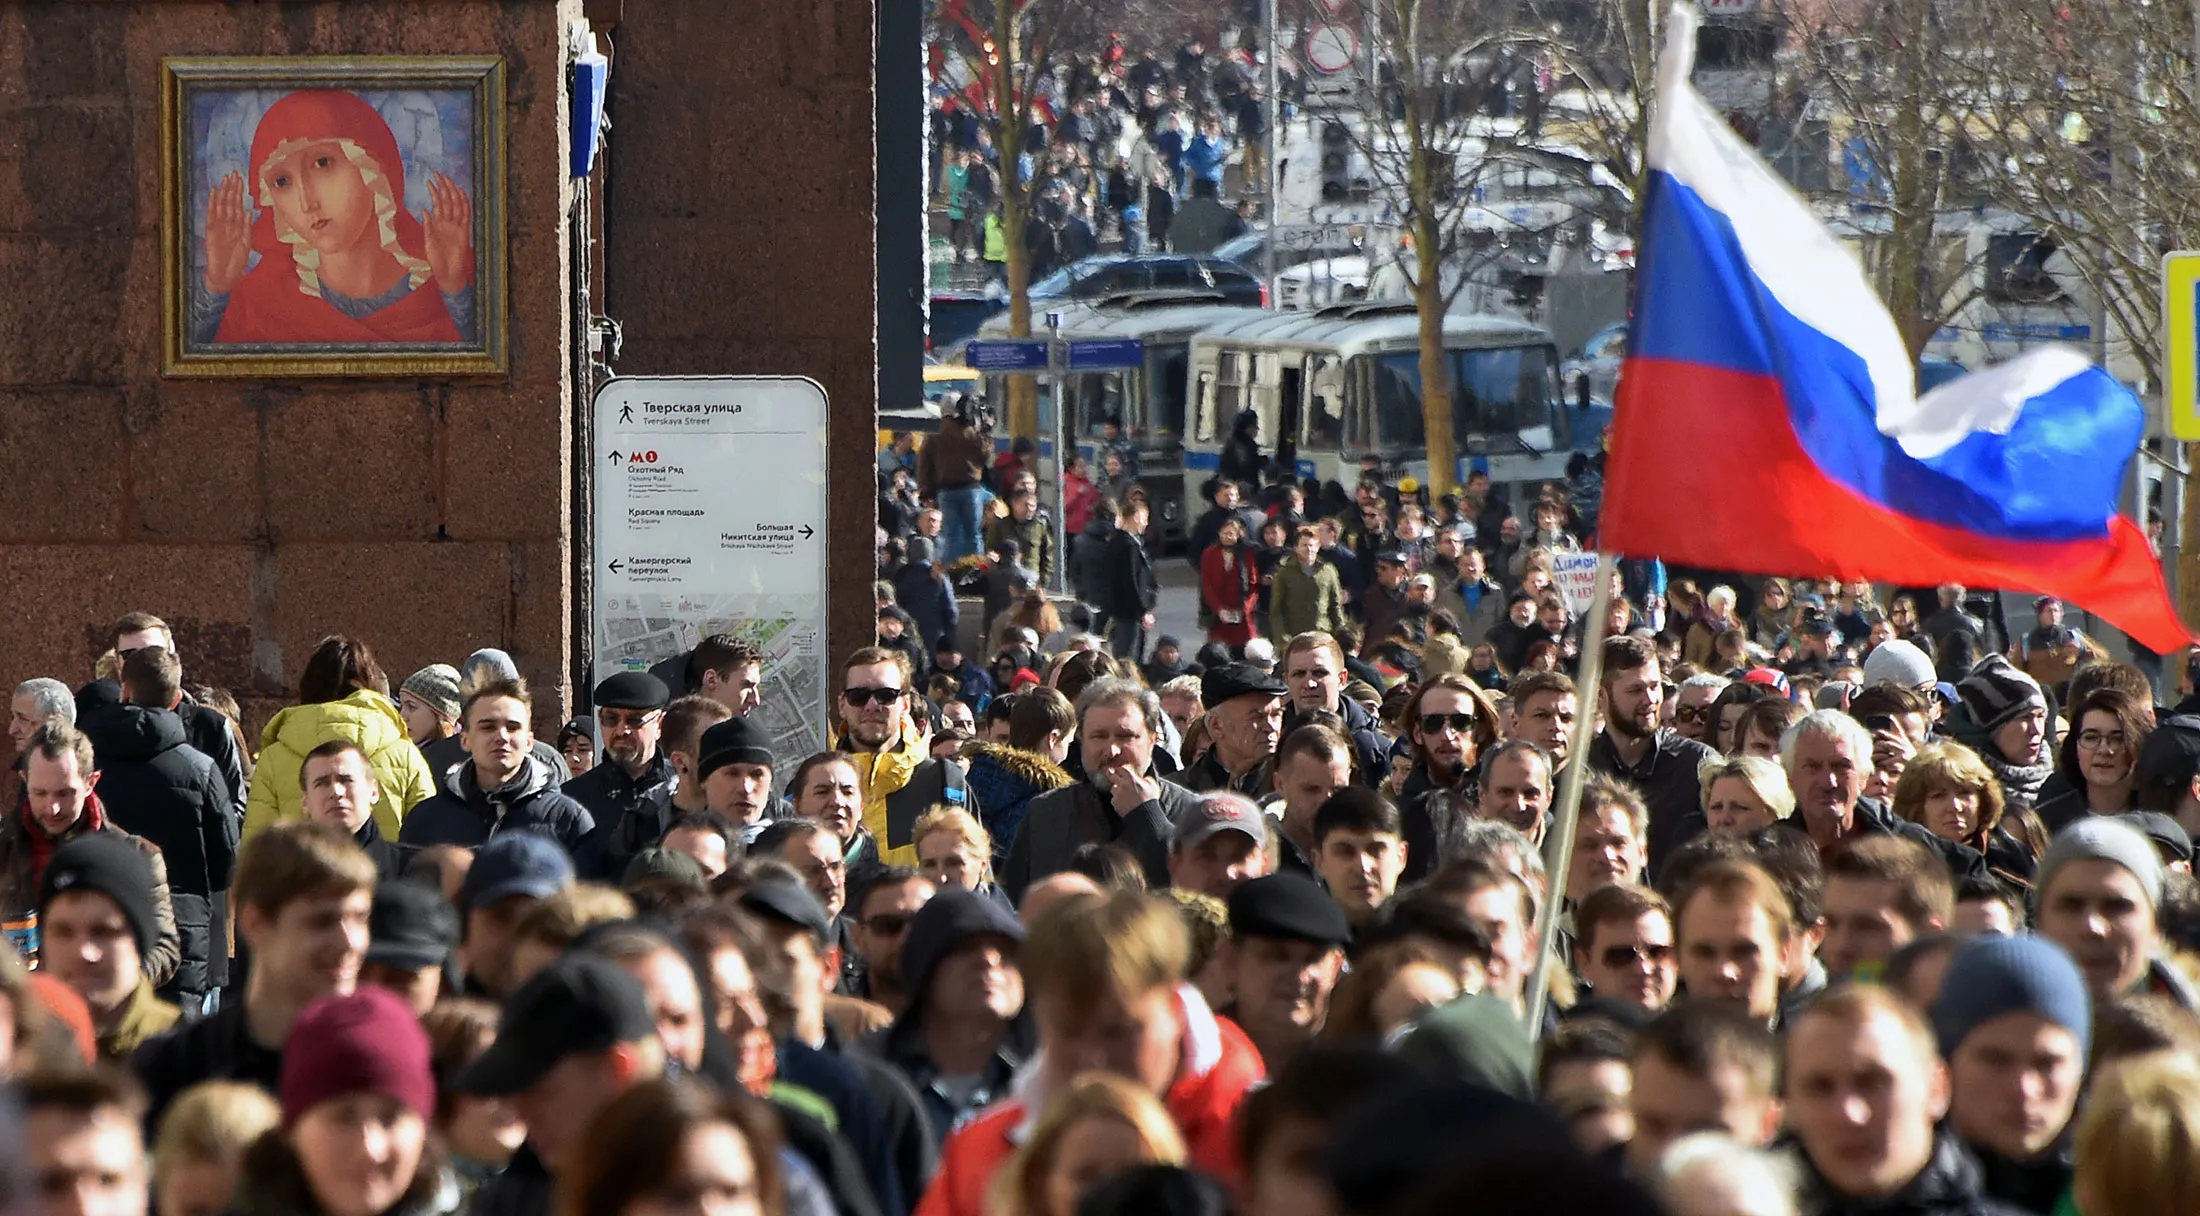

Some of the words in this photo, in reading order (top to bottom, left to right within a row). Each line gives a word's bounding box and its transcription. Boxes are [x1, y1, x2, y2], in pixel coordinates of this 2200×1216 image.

[643, 402, 701, 415] Тверская
[704, 404, 742, 415] улица
[643, 417, 682, 426] Tverskaya
[684, 417, 710, 425] Street
[628, 466, 666, 474] Охотный
[668, 466, 685, 475] Ряд
[628, 508, 665, 517] Красная
[667, 509, 705, 517] площадь
[756, 523, 794, 531] Большая
[721, 533, 767, 541] Никитская
[769, 534, 794, 542] улица
[628, 556, 692, 565] Камергерский
[628, 568, 669, 576] переулок
